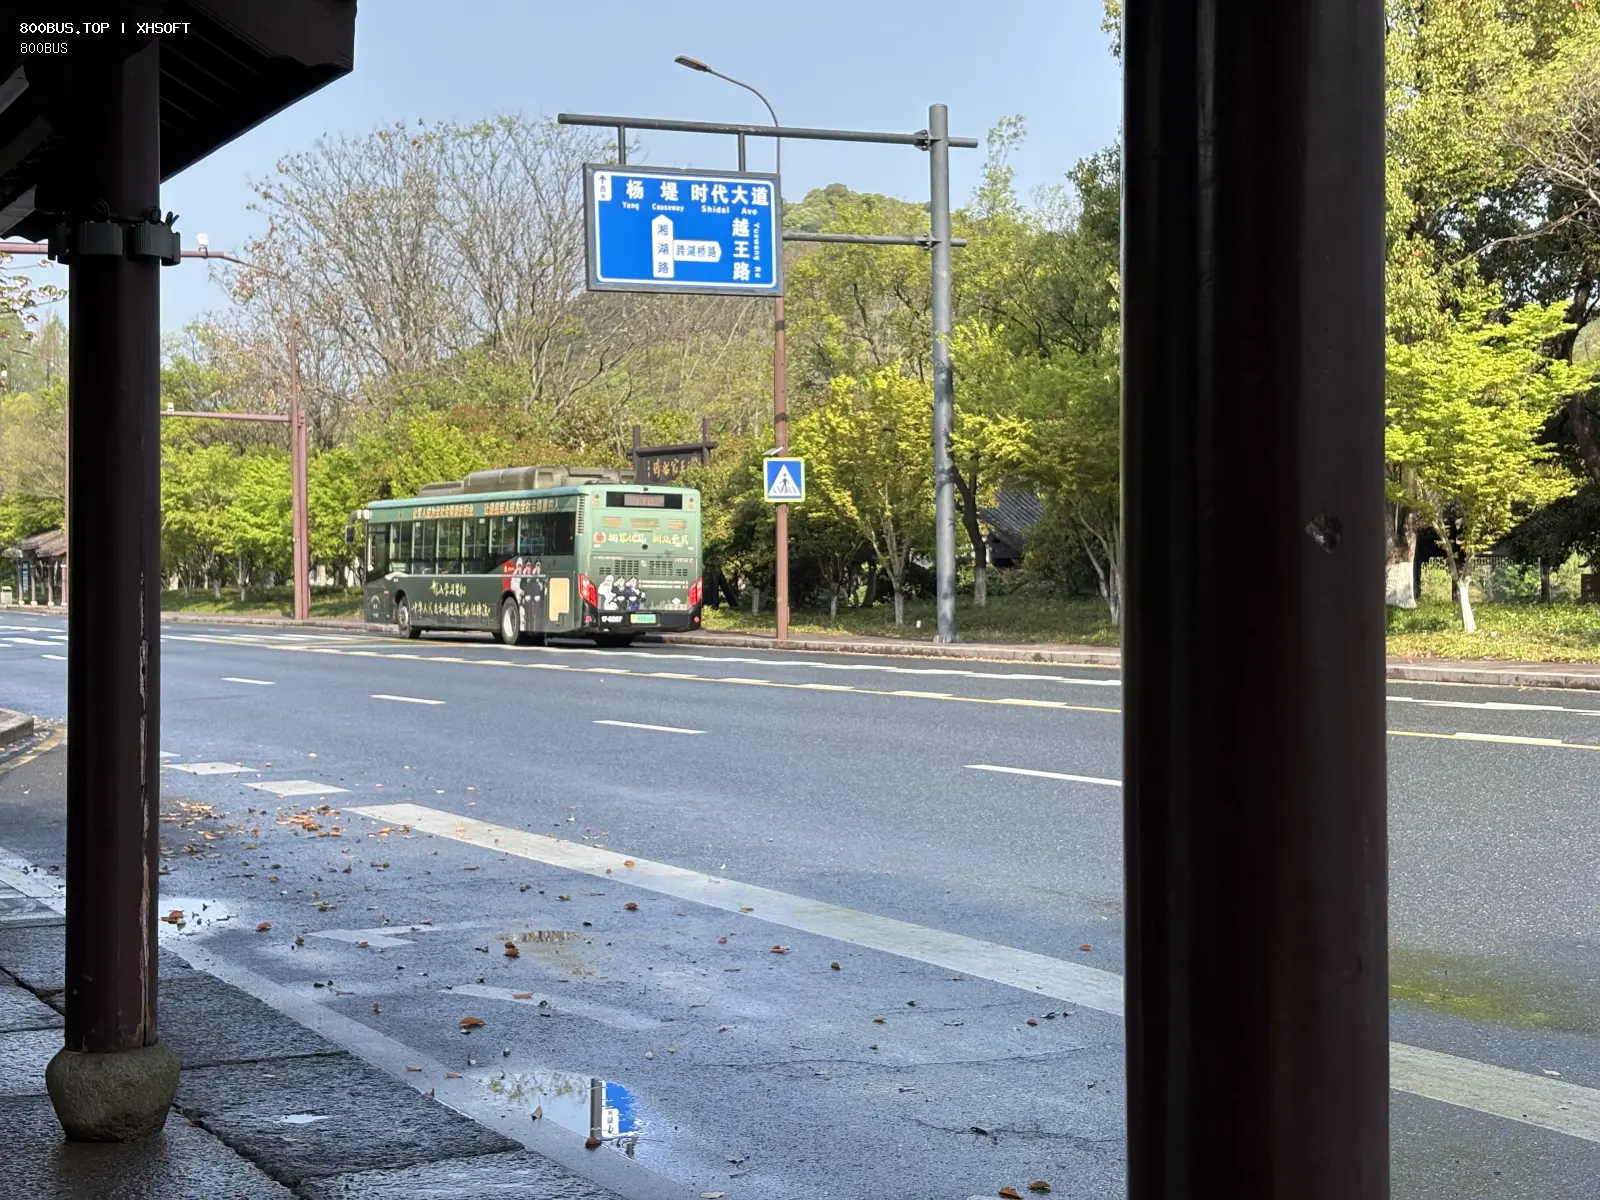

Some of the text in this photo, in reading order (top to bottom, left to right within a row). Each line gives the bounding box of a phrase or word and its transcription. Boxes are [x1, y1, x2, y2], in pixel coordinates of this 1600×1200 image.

[625, 179, 769, 206] 杨堤 时代大道
[621, 201, 758, 216] Yang Causeway Shidai Ave
[657, 223, 669, 274] 湘湖路
[676, 244, 716, 258] 跨湖桥路
[731, 217, 751, 281] 越王路
